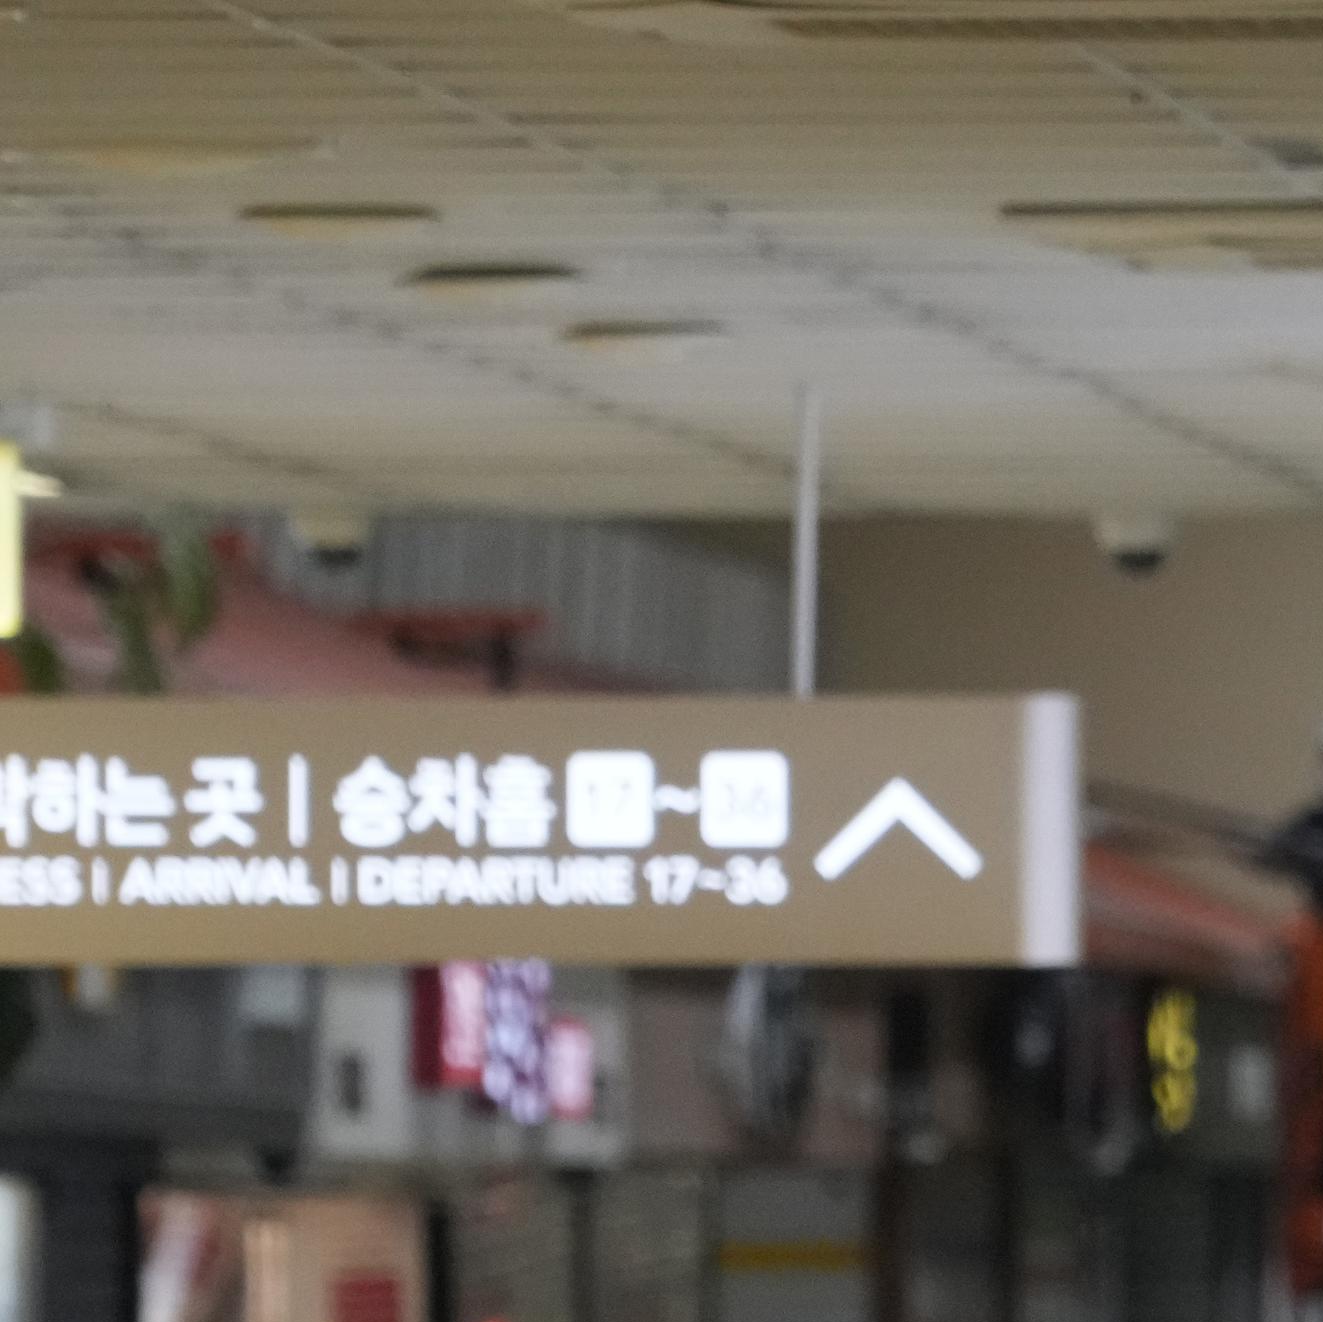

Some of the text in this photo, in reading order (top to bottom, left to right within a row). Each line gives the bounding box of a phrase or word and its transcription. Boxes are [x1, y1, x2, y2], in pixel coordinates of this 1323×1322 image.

[183, 757, 264, 847] 곳
[332, 753, 557, 848] 승차홈
[119, 856, 320, 905] ARRIVAL
[357, 855, 635, 905] DEPARTURE
